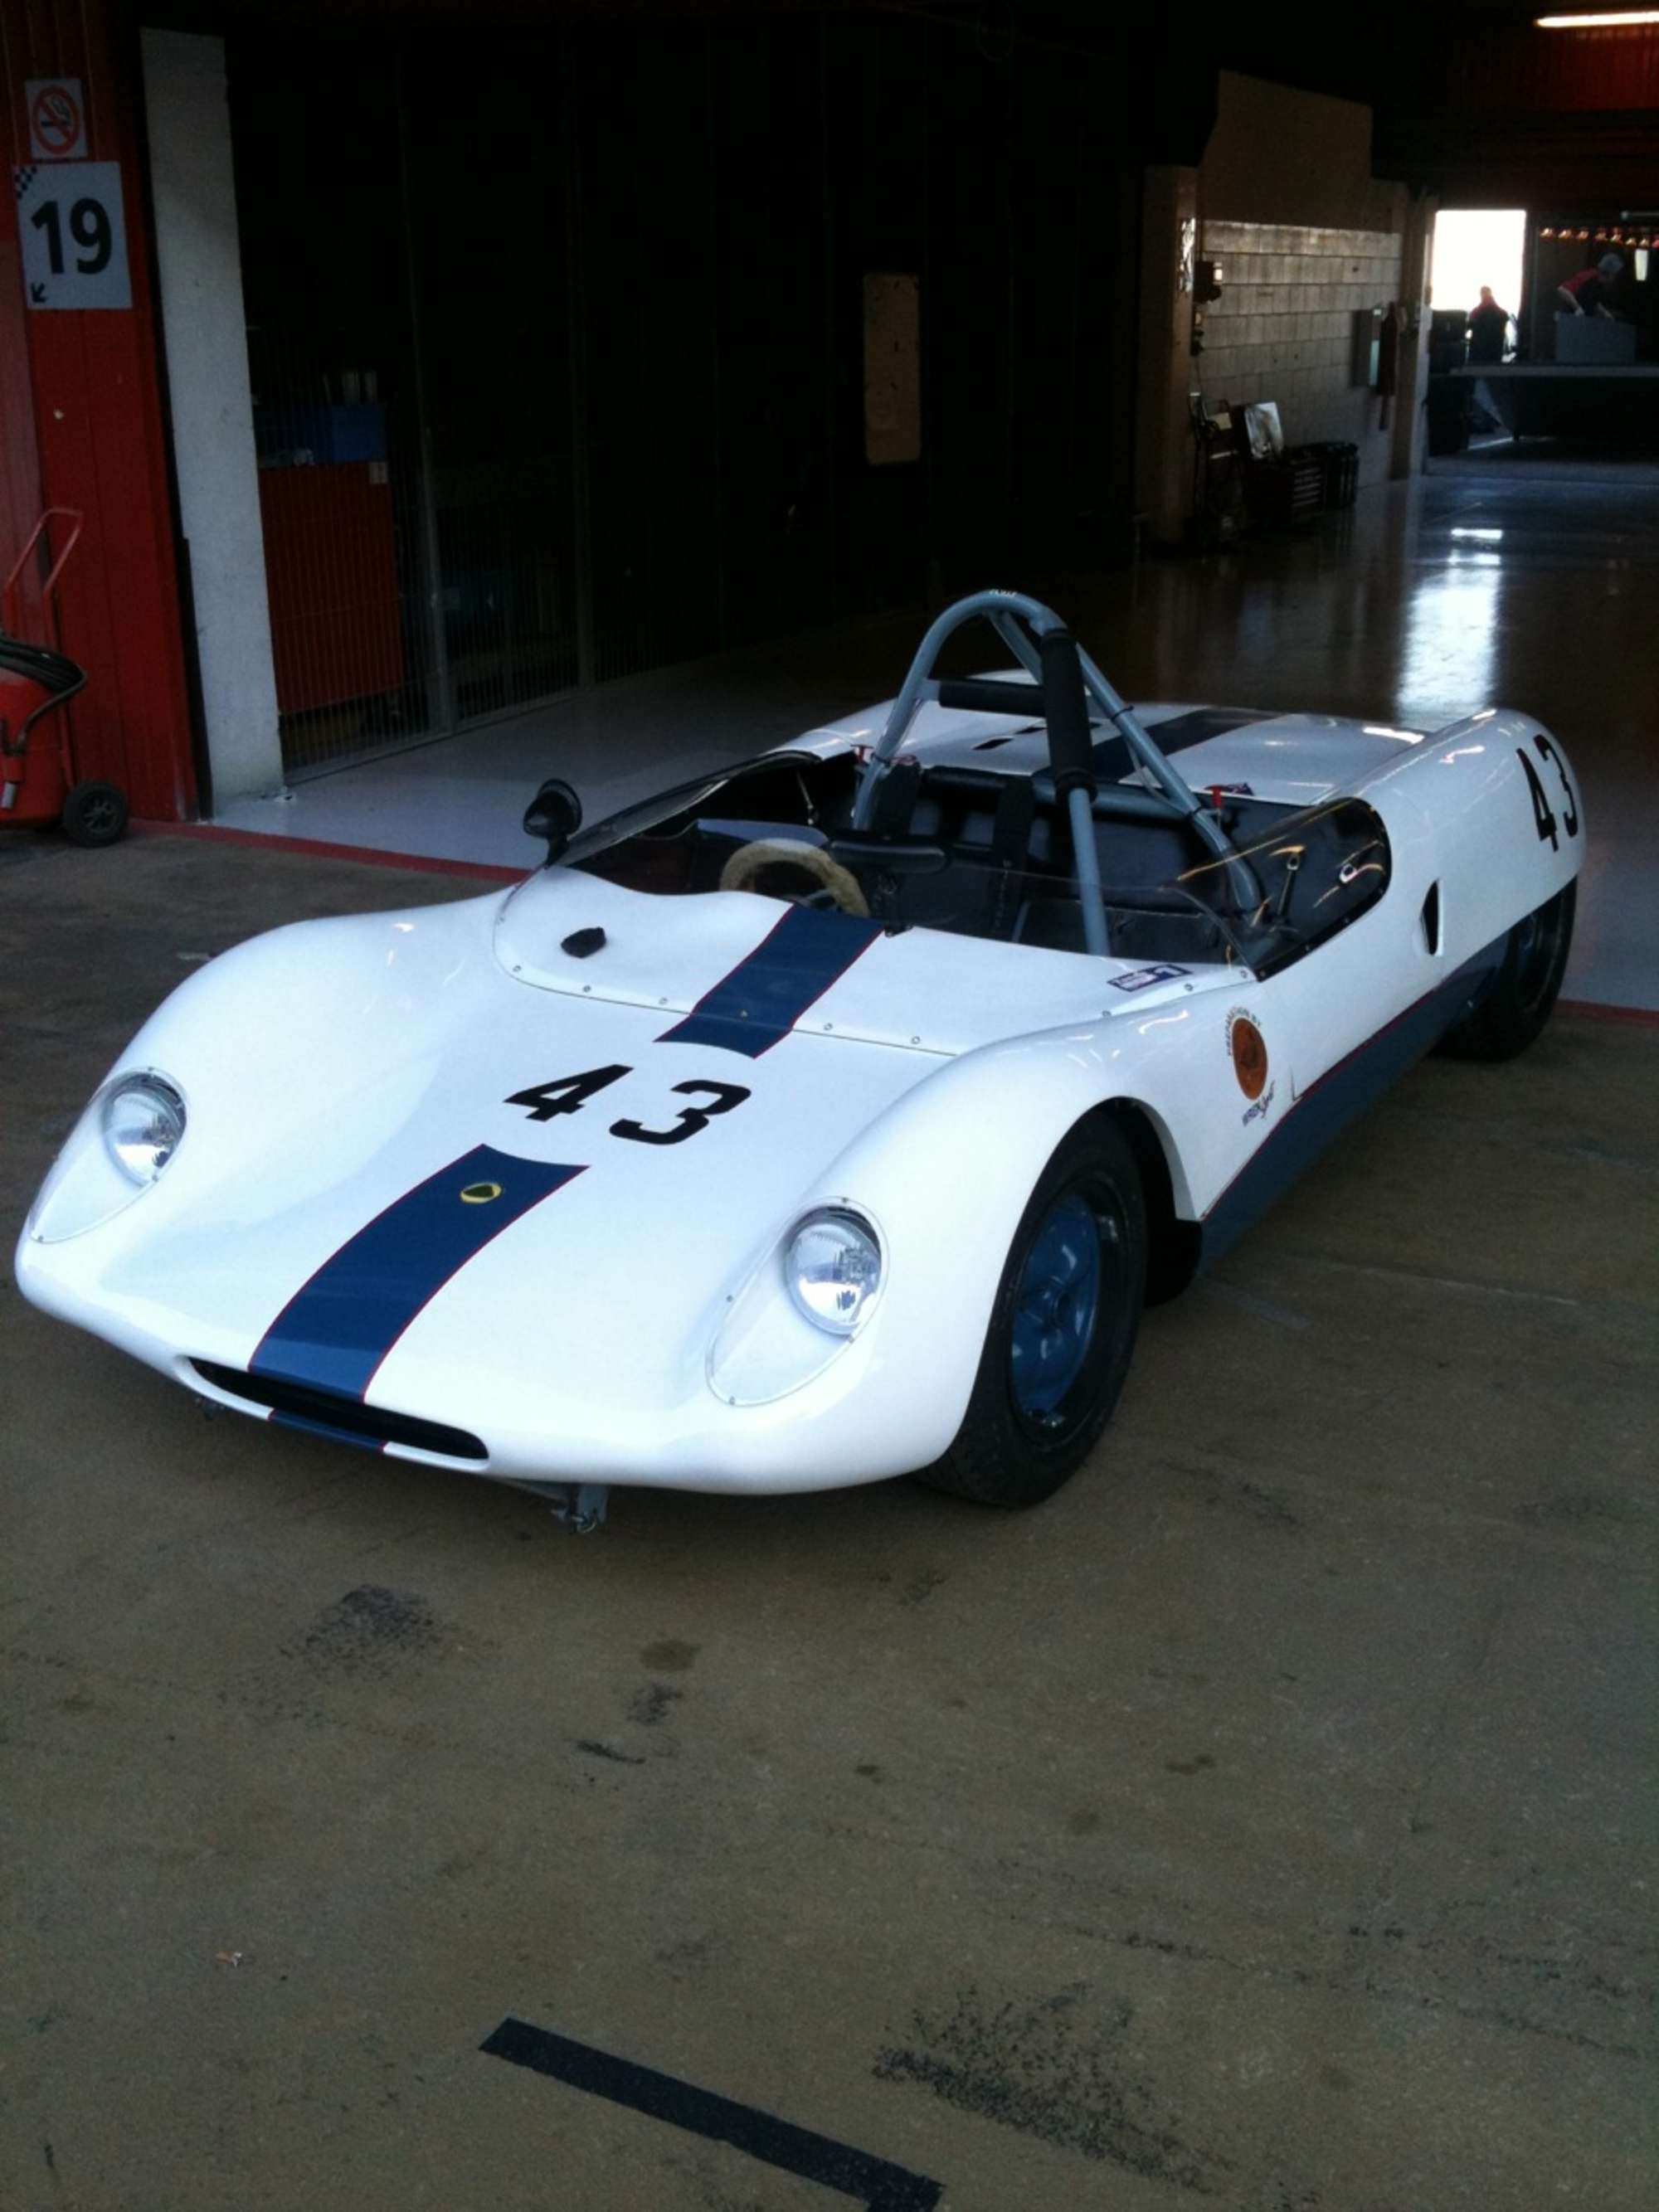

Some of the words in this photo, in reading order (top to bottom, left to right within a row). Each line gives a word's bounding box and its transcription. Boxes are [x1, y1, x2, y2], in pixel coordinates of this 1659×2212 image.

[31, 198, 112, 275] 19
[1516, 734, 1578, 852] 43
[503, 1064, 752, 1145] 43
